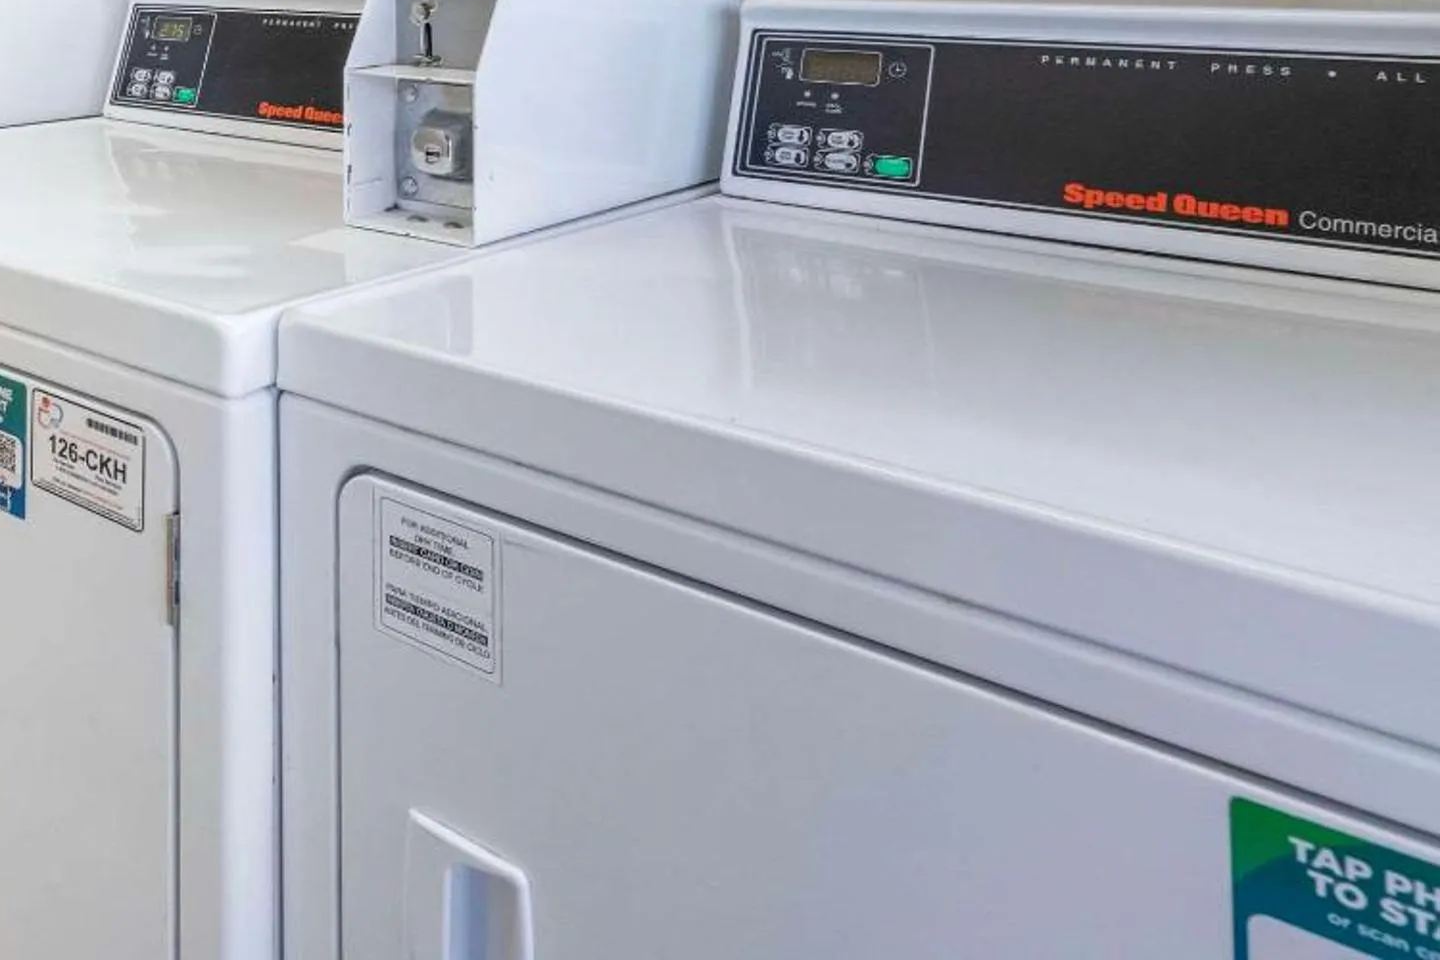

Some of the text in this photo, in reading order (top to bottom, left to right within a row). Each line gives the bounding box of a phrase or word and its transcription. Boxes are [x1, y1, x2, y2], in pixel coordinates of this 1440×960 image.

[1040, 54, 1427, 84] PERMANENT PRESS ALL
[257, 101, 344, 124] Speed Quee
[1063, 182, 1167, 213] Speed
[1174, 193, 1290, 227] Queen
[49, 434, 127, 484] 126-CKH
[1288, 835, 1373, 882] TAP
[1307, 869, 1368, 910] TO
[1327, 912, 1351, 928] or
[1357, 924, 1410, 952] scan
